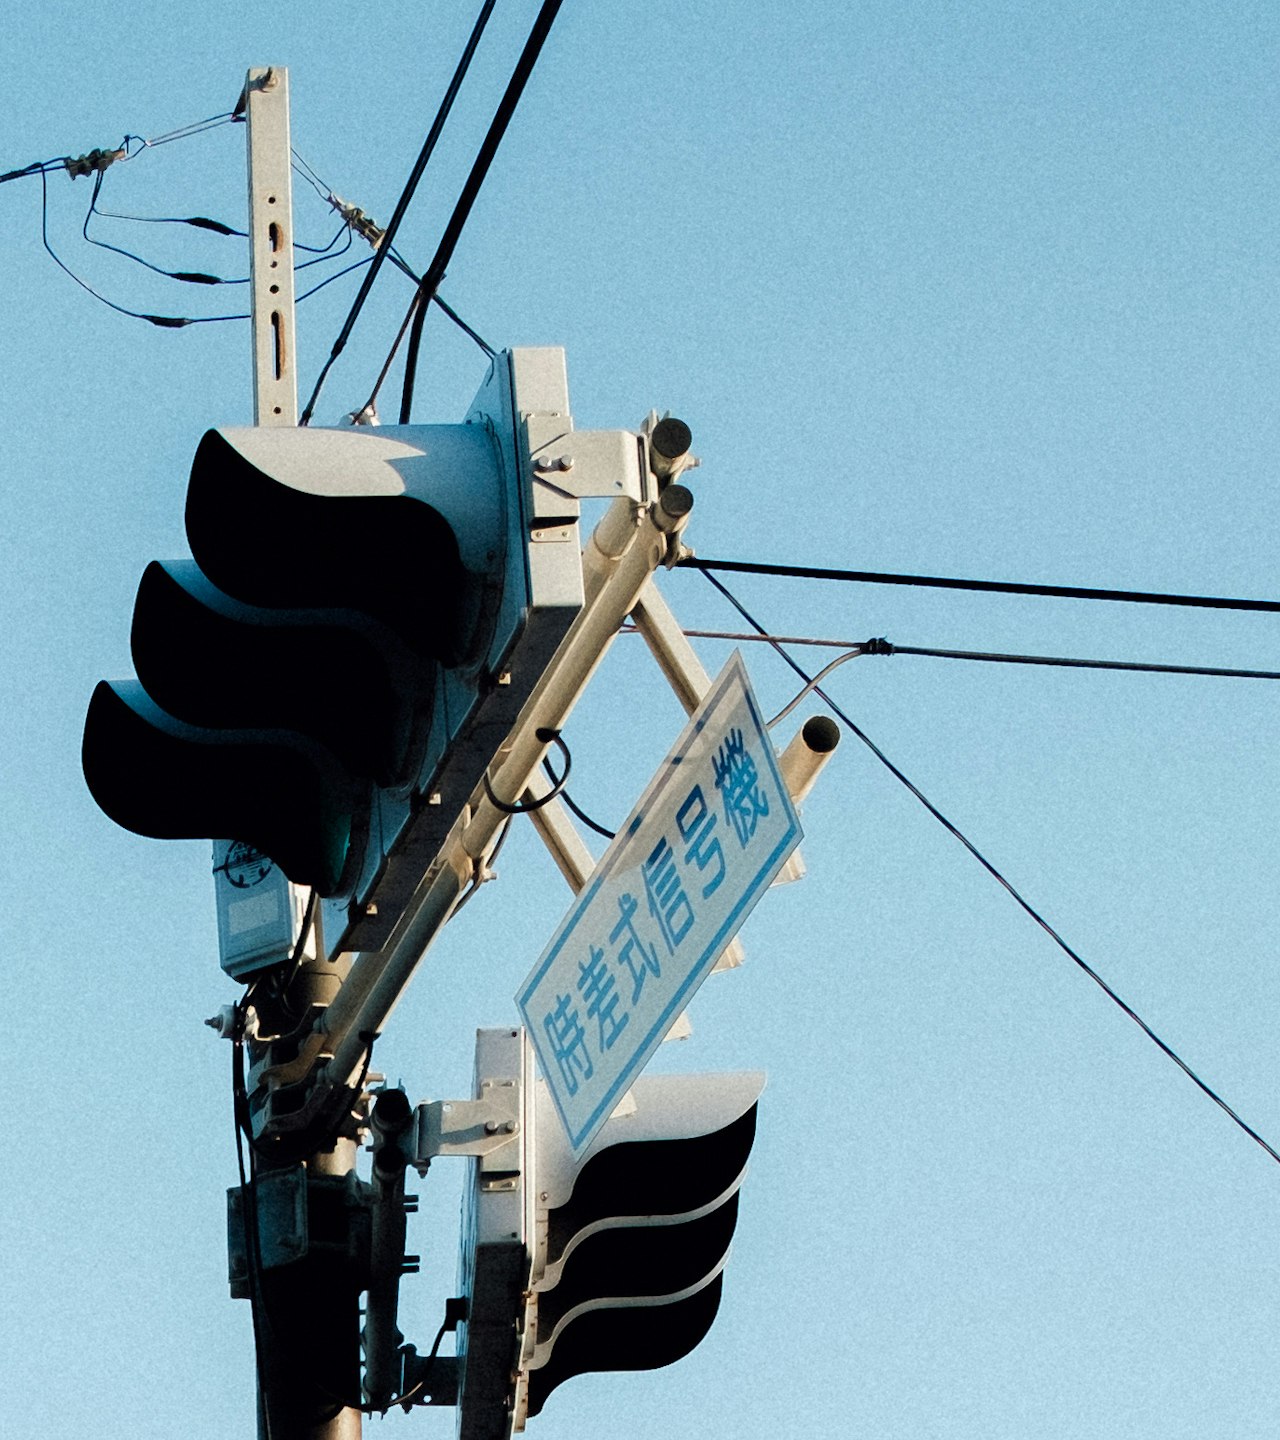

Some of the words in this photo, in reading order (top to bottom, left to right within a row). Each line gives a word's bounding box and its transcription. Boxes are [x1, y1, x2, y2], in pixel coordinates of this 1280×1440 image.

[542, 727, 770, 1098] 時差式信号機
